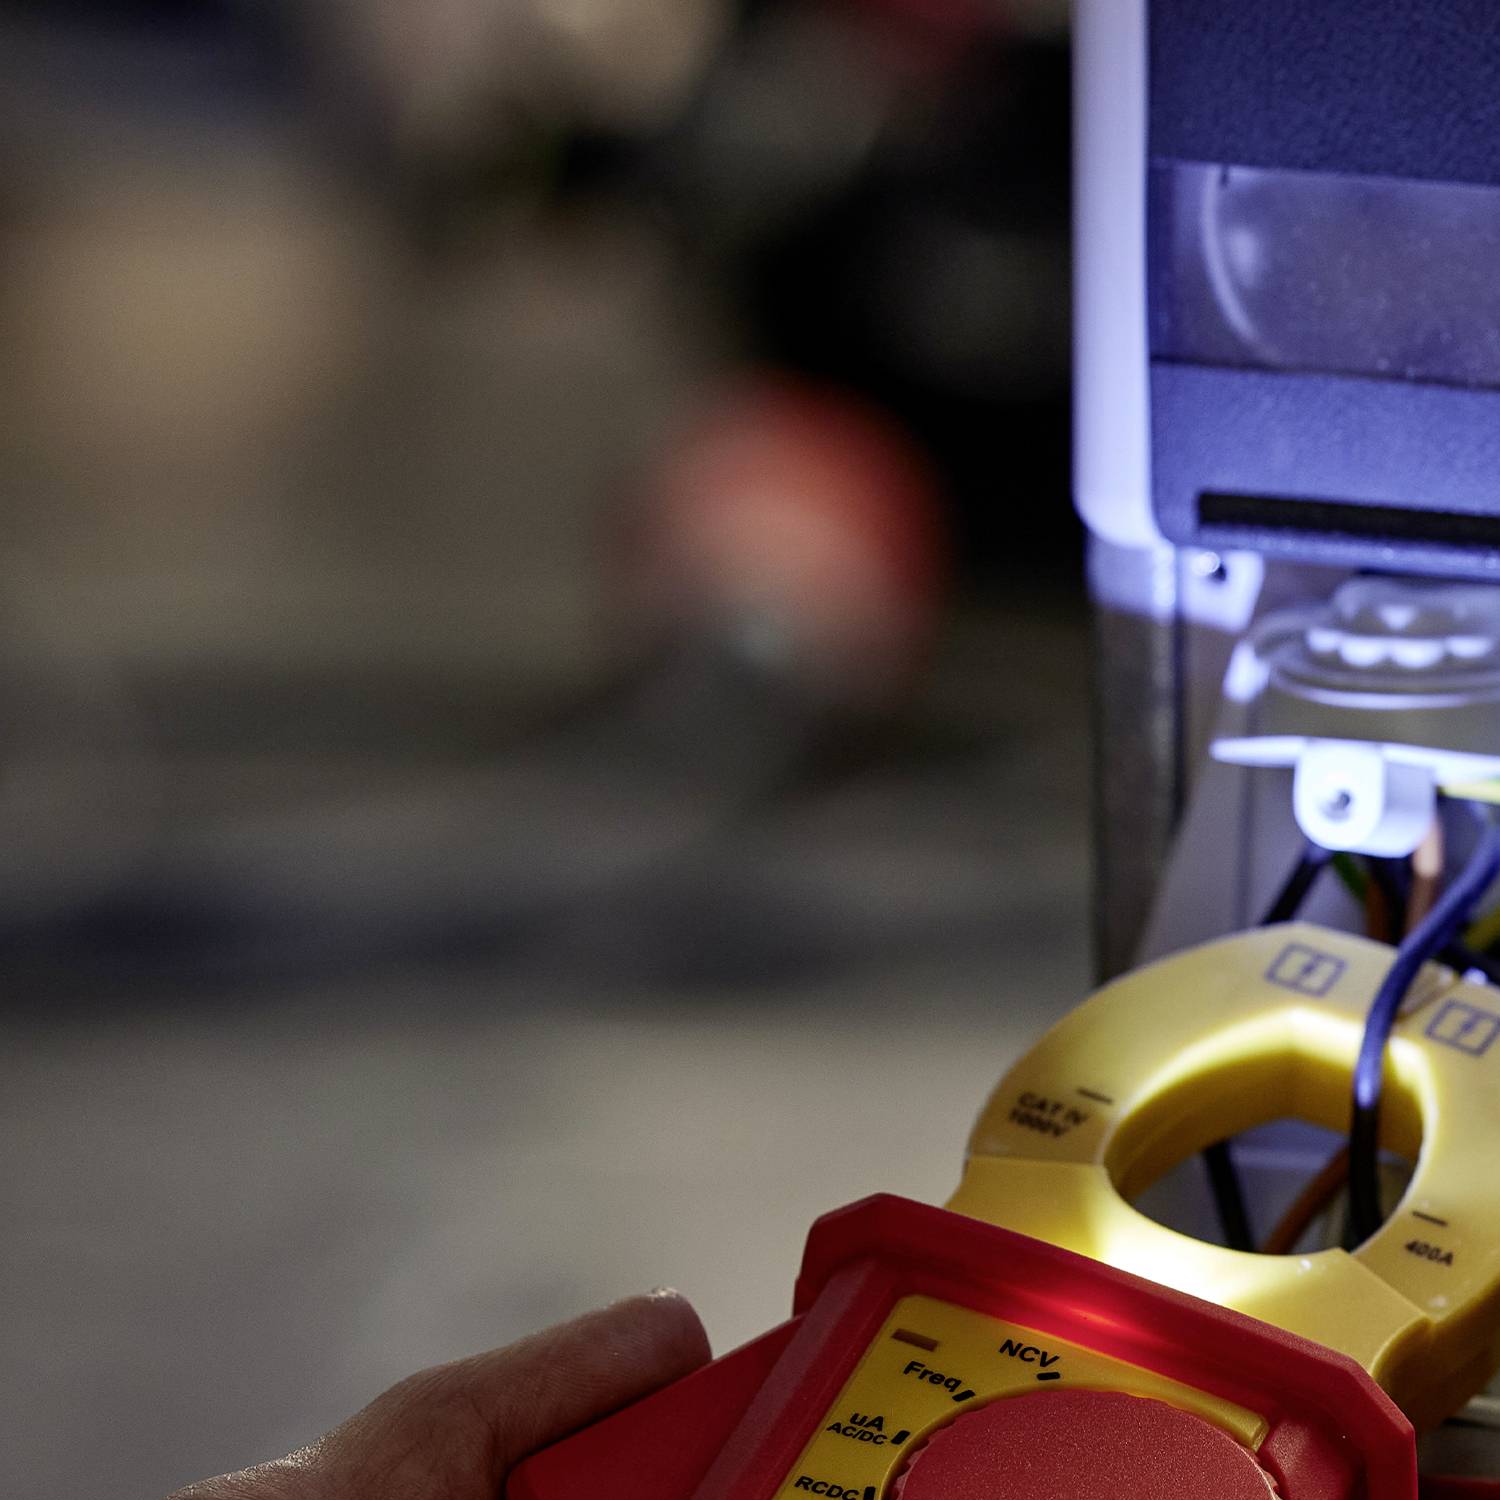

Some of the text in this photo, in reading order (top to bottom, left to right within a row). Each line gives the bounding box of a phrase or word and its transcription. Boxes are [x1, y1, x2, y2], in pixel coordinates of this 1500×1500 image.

[999, 1338, 1060, 1369] NCV
[903, 1361, 962, 1392] Freq
[826, 1421, 888, 1446] AC/DC
